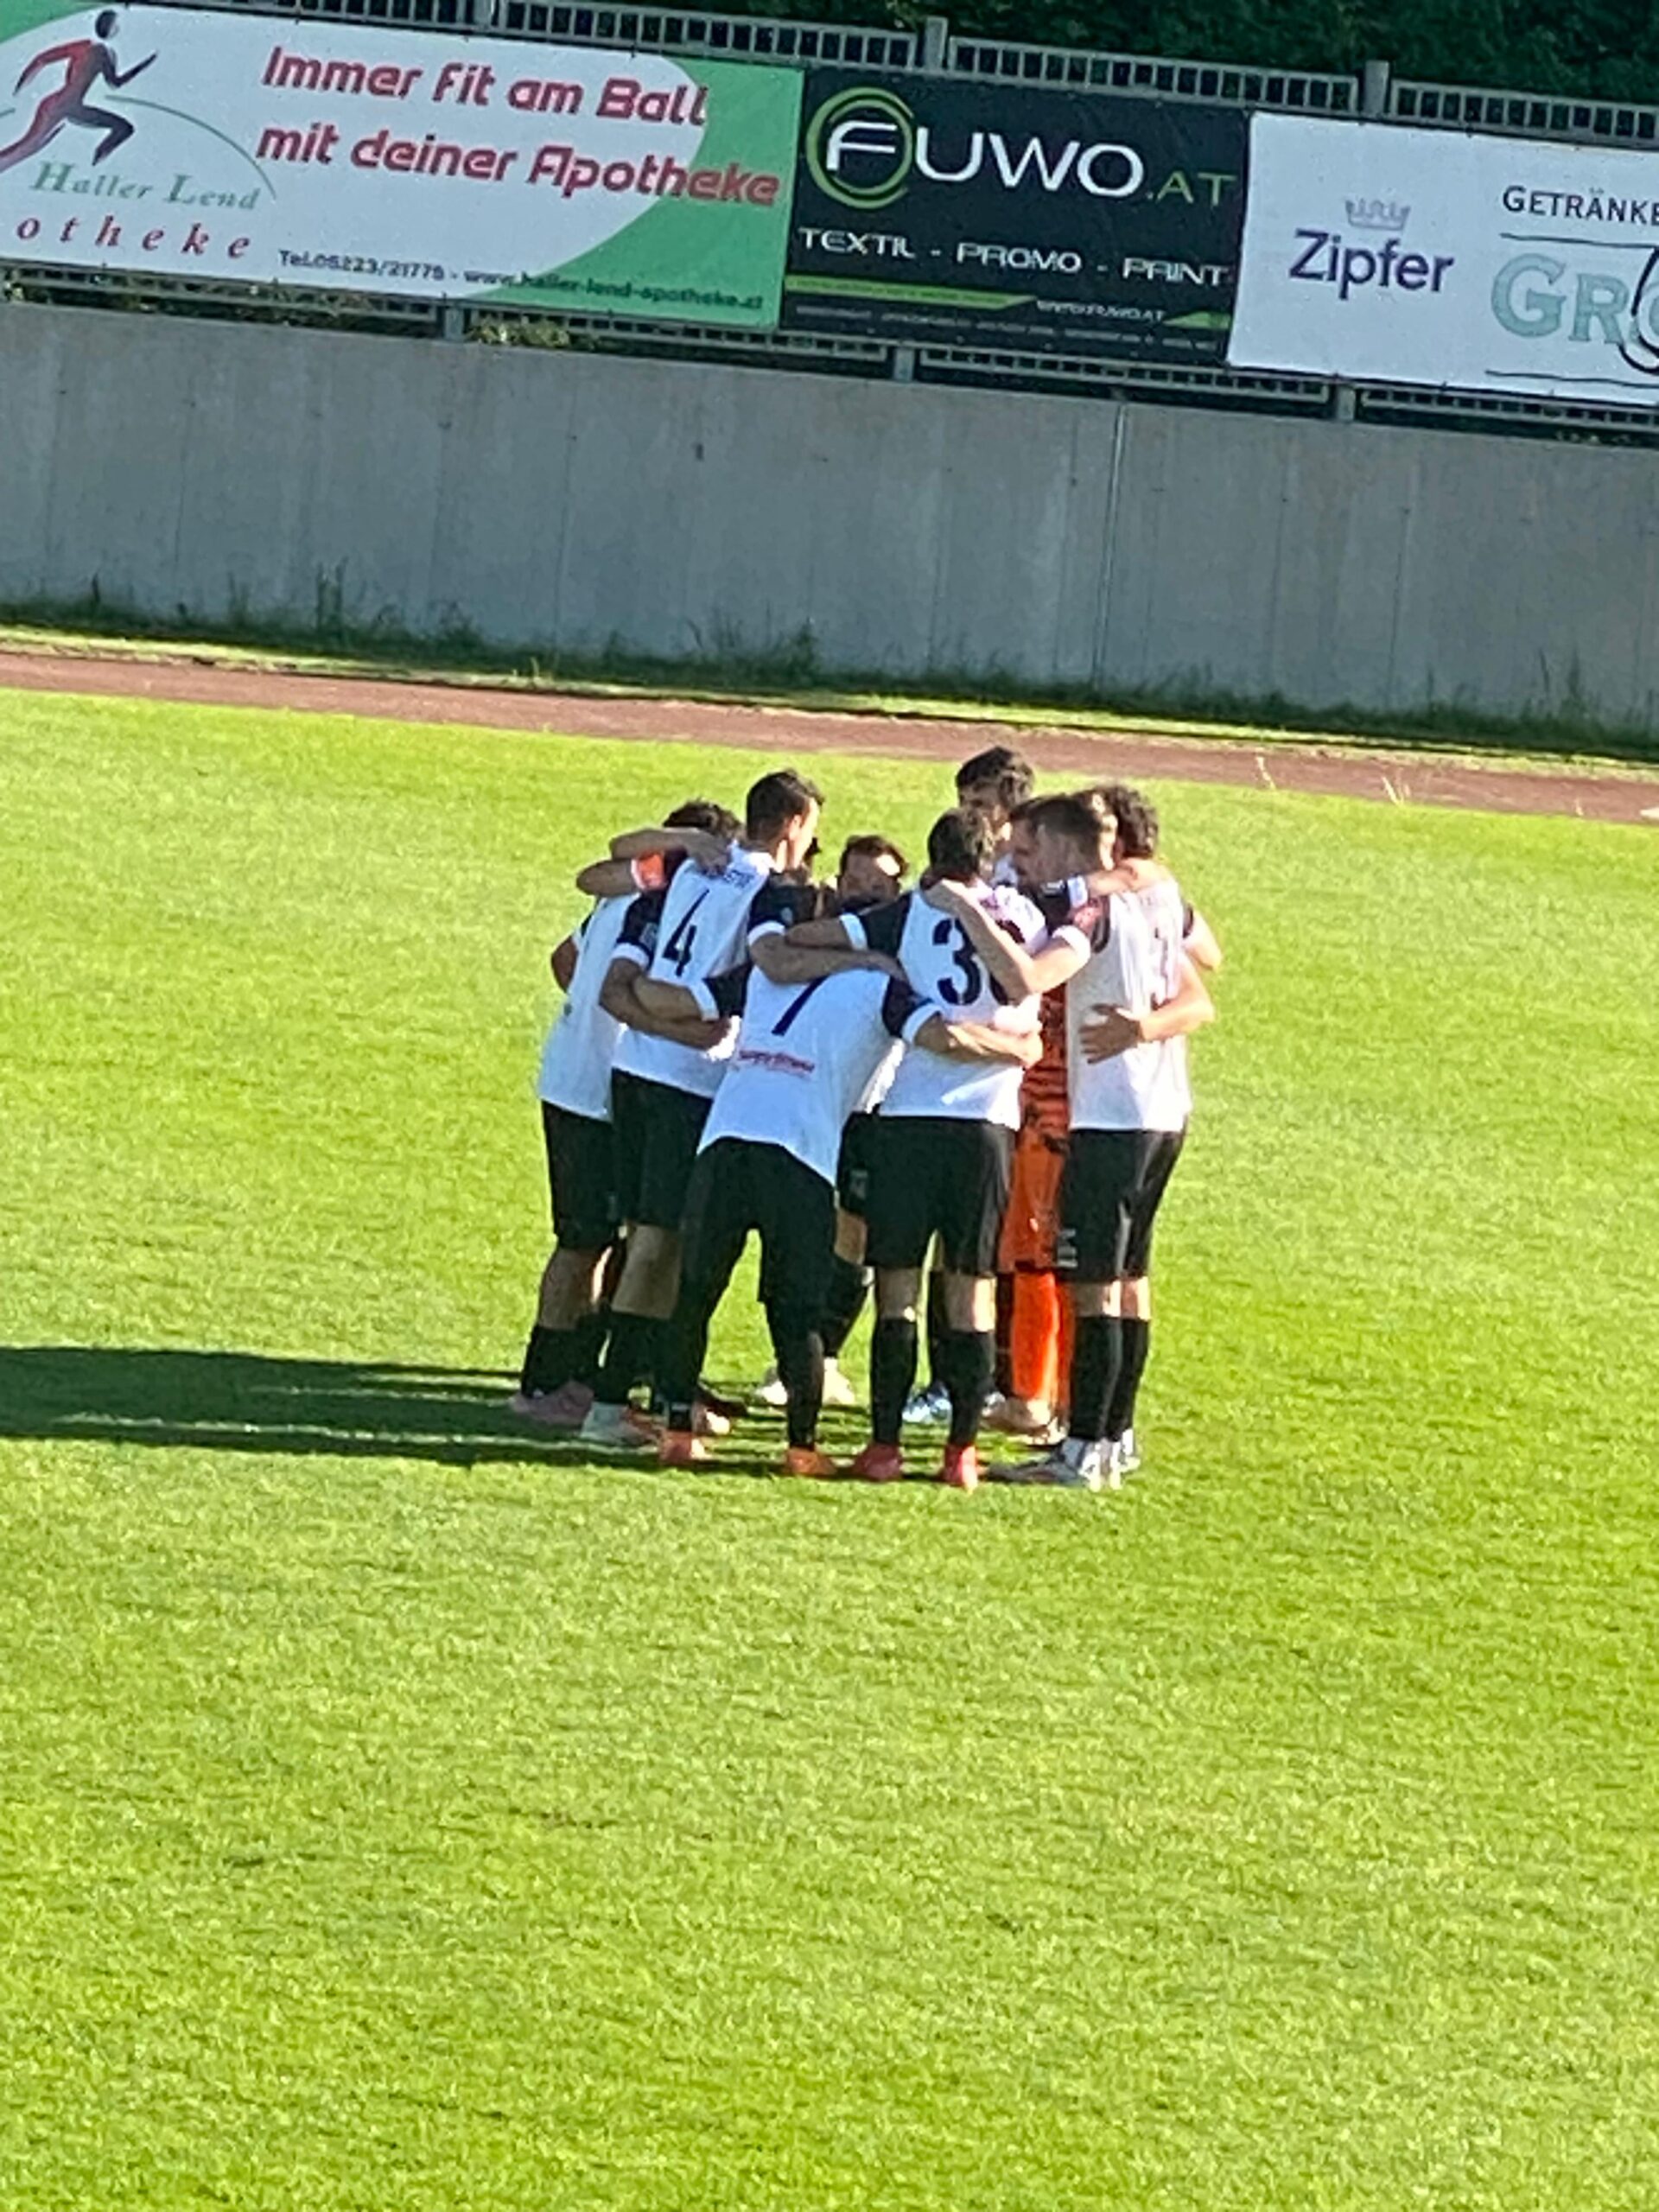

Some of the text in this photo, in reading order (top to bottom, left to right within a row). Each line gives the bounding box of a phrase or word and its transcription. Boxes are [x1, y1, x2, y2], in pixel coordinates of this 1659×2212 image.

[262, 46, 423, 99] Immer
[507, 79, 584, 115] am
[596, 79, 709, 125] Ball
[29, 161, 261, 211] Haller Lend
[257, 122, 782, 207] mit deiner Apotheke
[1502, 183, 1659, 227] GETRÄNKE
[799, 226, 916, 259] TEXTIL
[957, 240, 1084, 275] PROMO
[1122, 257, 1230, 288] PRINT
[1289, 228, 1455, 301] Zipfer
[662, 886, 710, 977] 4
